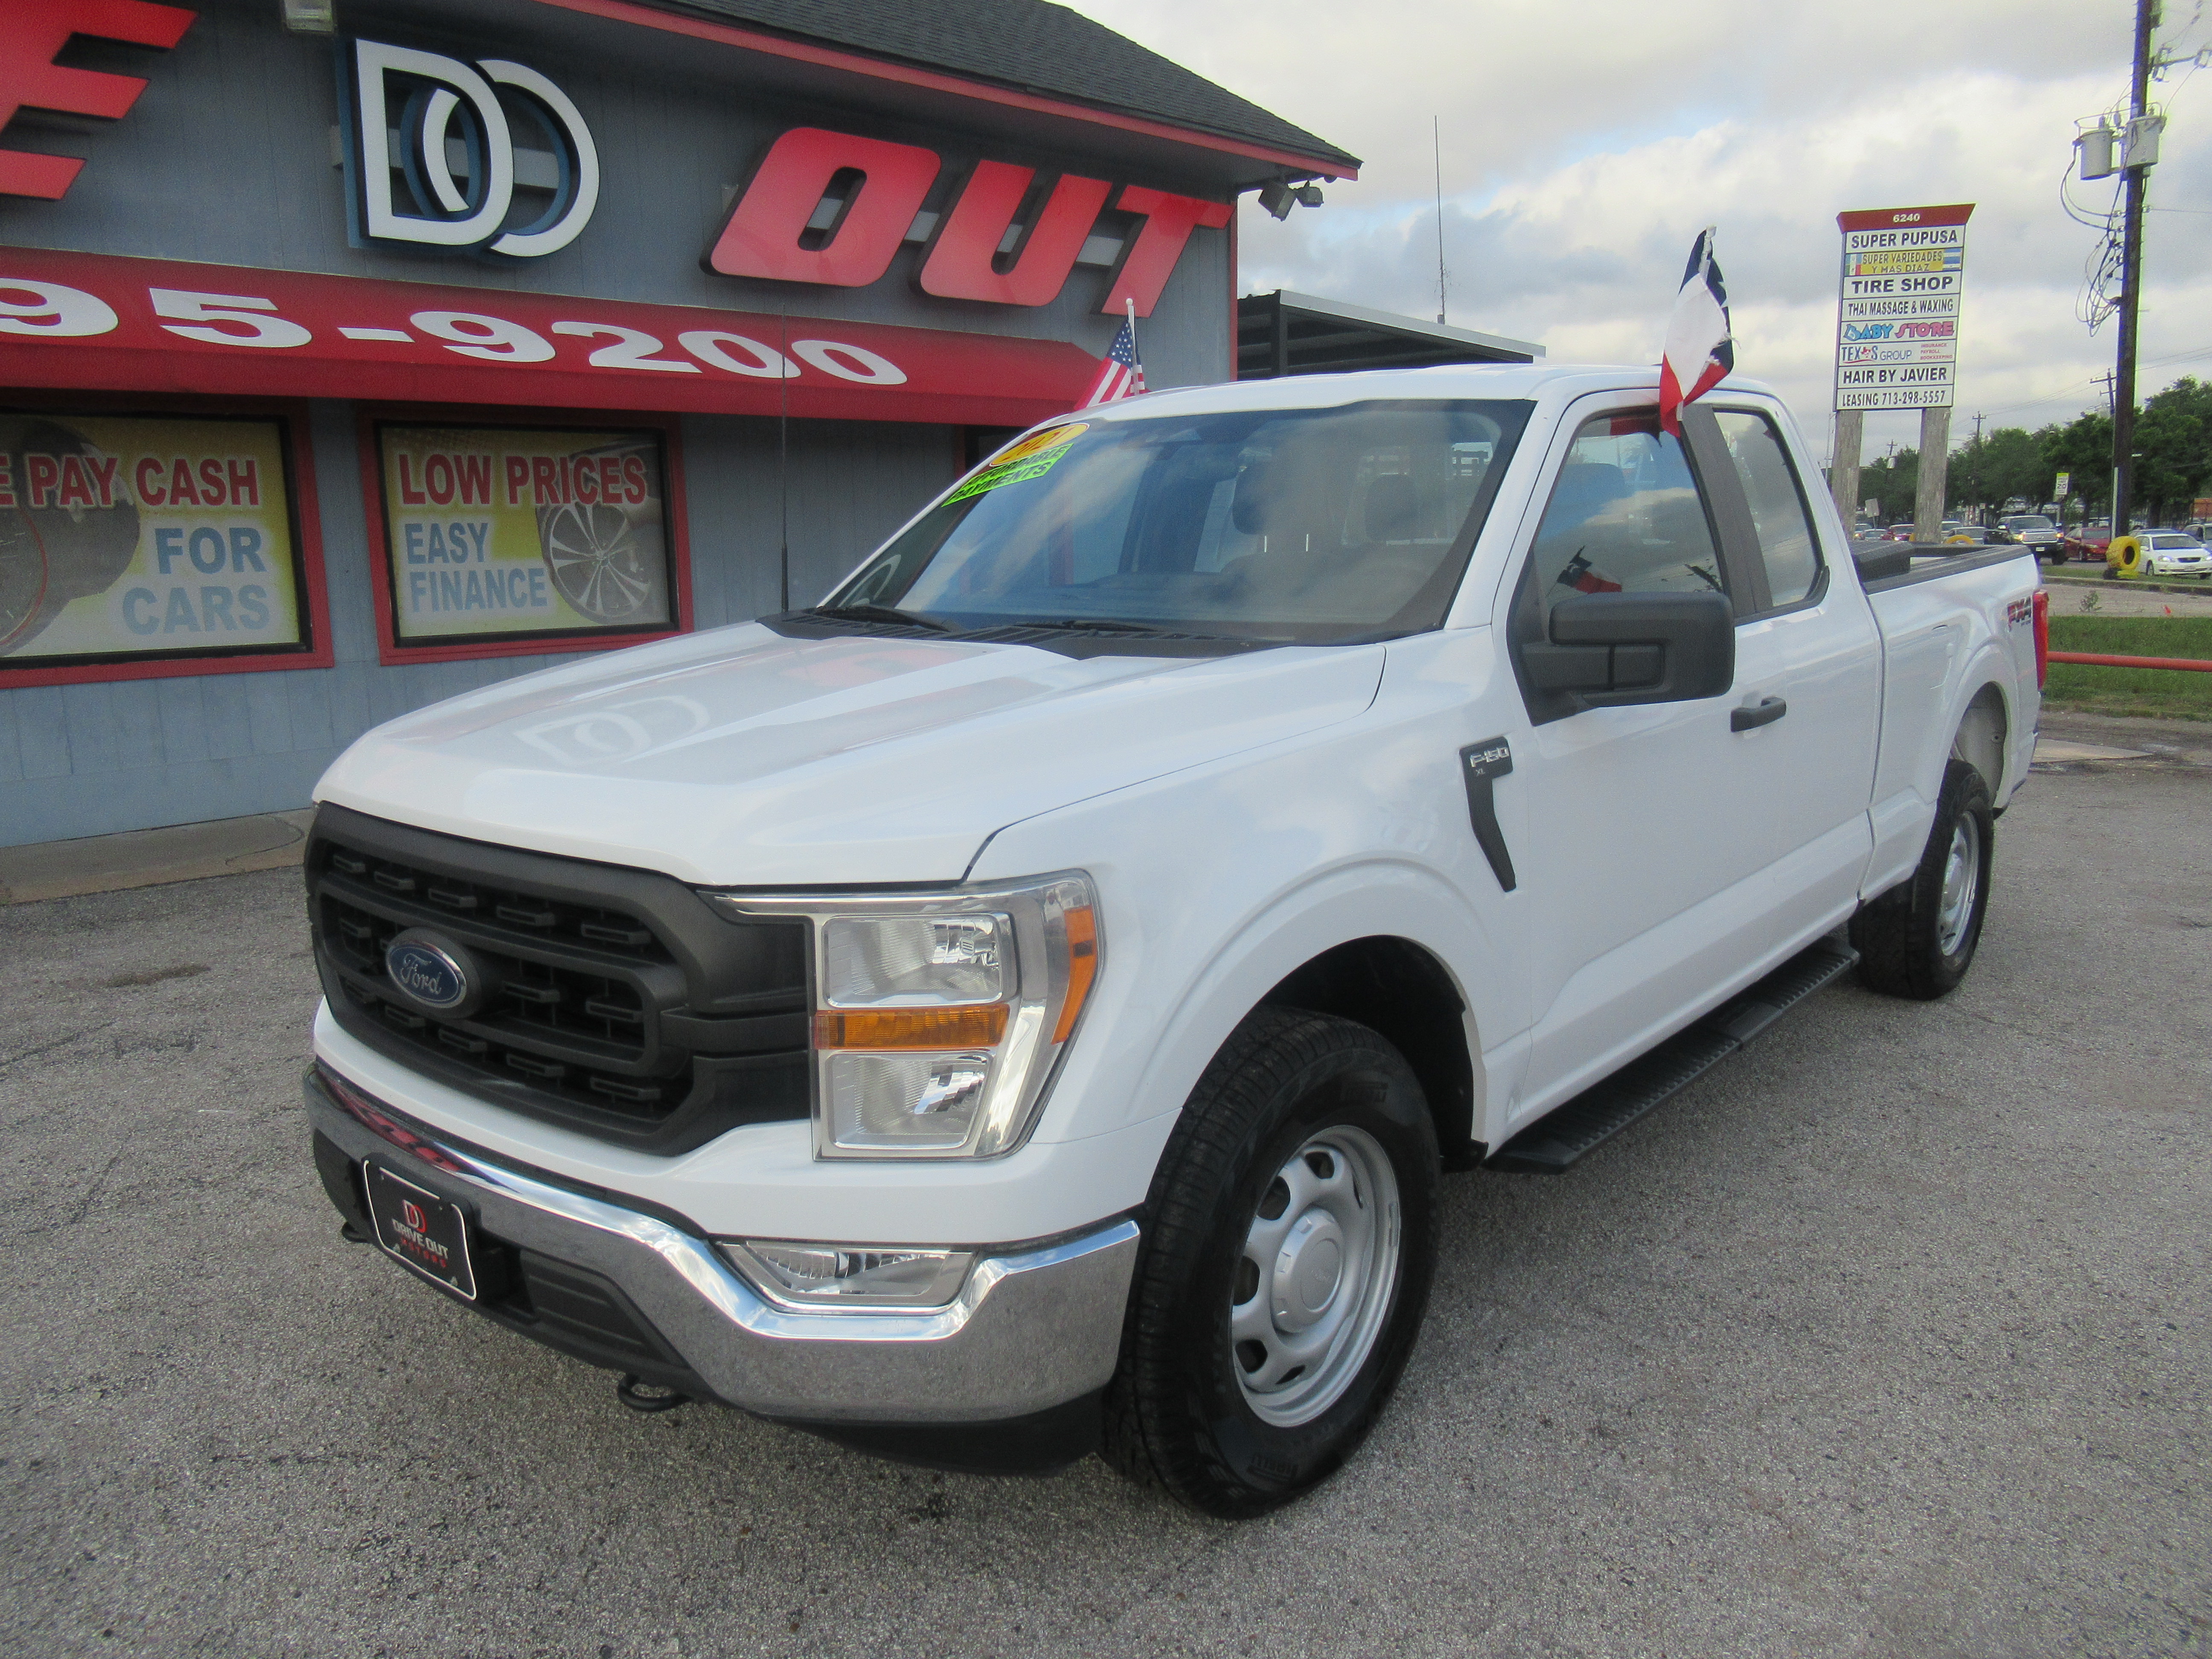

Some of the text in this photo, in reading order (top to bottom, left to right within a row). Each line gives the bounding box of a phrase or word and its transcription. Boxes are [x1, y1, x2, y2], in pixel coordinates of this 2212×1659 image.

[708, 126, 1236, 318] OUT
[1892, 213, 1920, 223] 6240
[1851, 230, 1958, 248] SUPER PUPUSA
[1862, 250, 1942, 265] SUPER VARIEDADES
[1881, 264, 1902, 273] MAS
[1905, 263, 1930, 272] DIAZ
[1851, 276, 1953, 294] TIRE SHOP
[1848, 298, 1953, 316] THAI MASSAGE & WAXING
[0, 277, 908, 385] 95-9200
[1843, 321, 1955, 341] BABY STORE
[1880, 349, 1912, 361] GROUP
[1843, 367, 1947, 384] HAIR BY JAVIER
[1842, 390, 1946, 406] LEASING 713-298-5557
[28, 456, 118, 505] PAY
[136, 457, 259, 506] CASH
[399, 454, 646, 505] LOW PRICES
[155, 527, 267, 574] FOR
[405, 523, 488, 564] EASY
[409, 568, 547, 612] FINANCE
[122, 585, 269, 635] CARS
[400, 954, 442, 995] Ford
[392, 1218, 425, 1247] DRIVE
[425, 1237, 448, 1260] OUT
